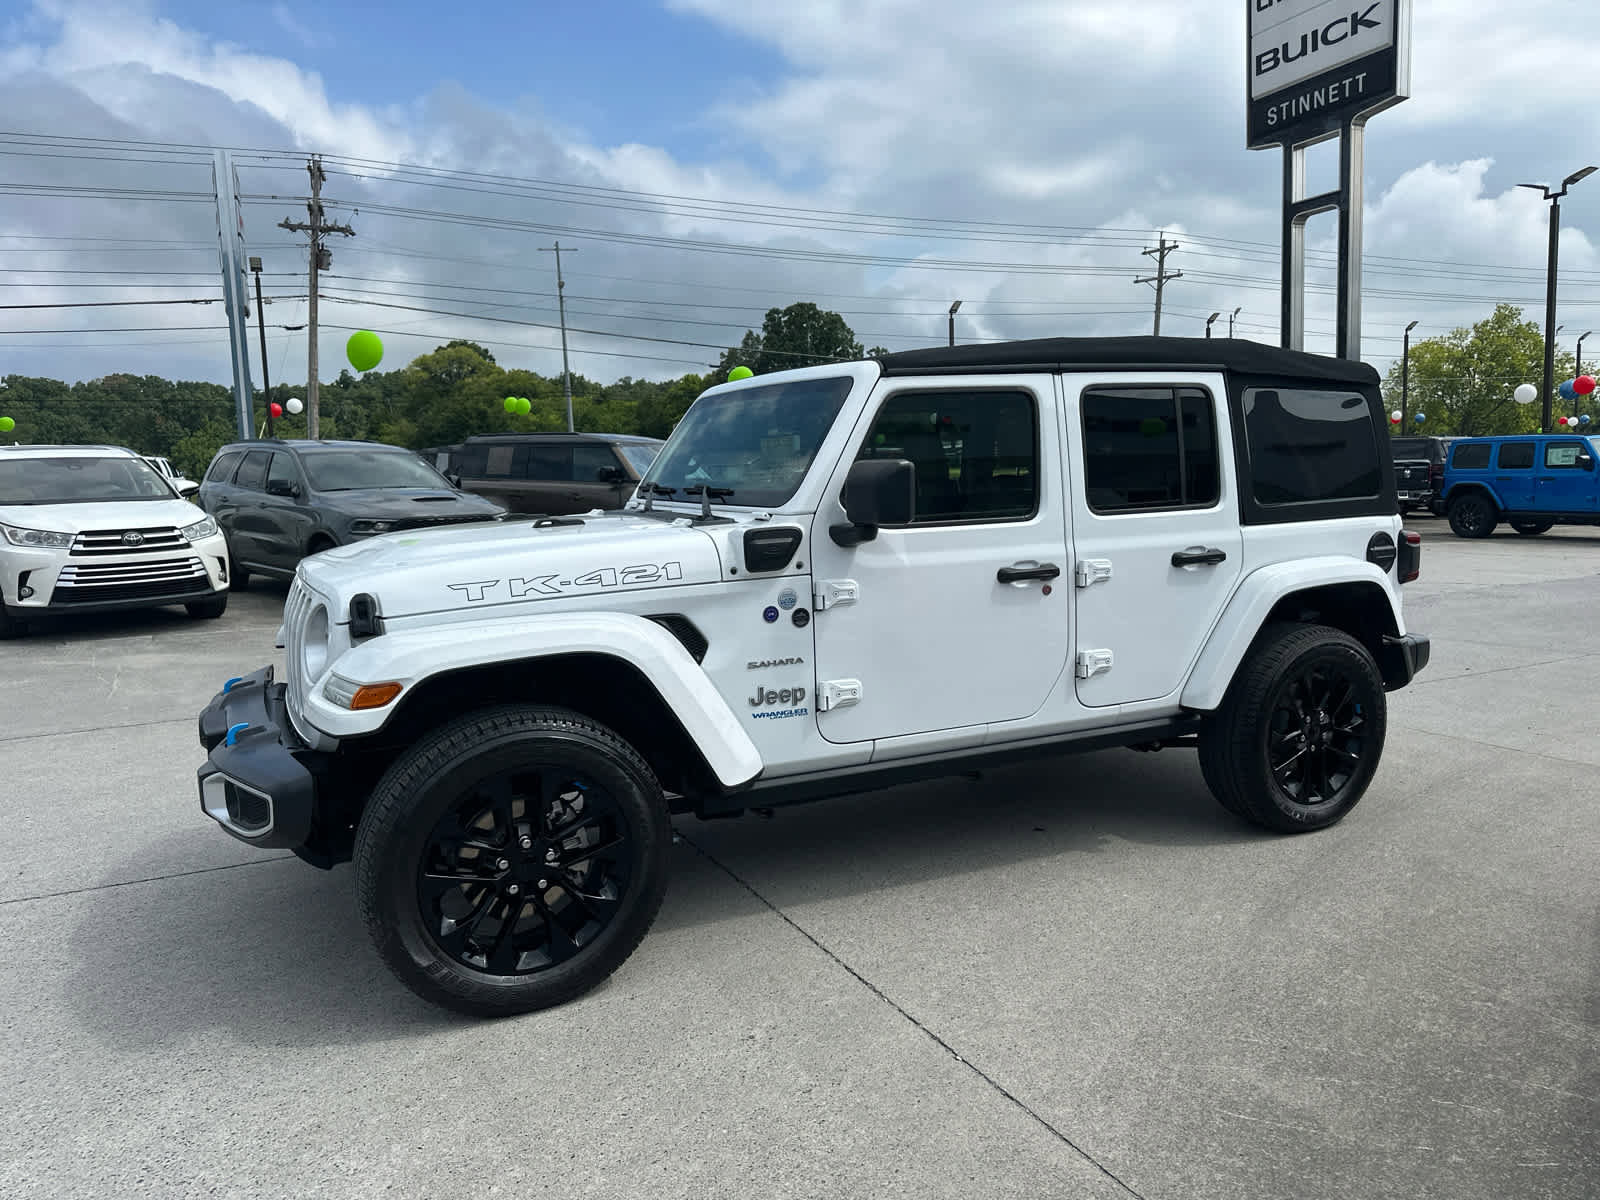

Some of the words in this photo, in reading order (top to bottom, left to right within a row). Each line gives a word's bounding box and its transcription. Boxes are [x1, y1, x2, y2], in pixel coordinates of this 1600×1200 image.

[1256, 2, 1381, 76] BUICK
[1267, 73, 1367, 125] STINNETT
[747, 657, 804, 670] SAHARA
[749, 686, 806, 706] Jeep
[752, 708, 808, 719] WRANGLER
